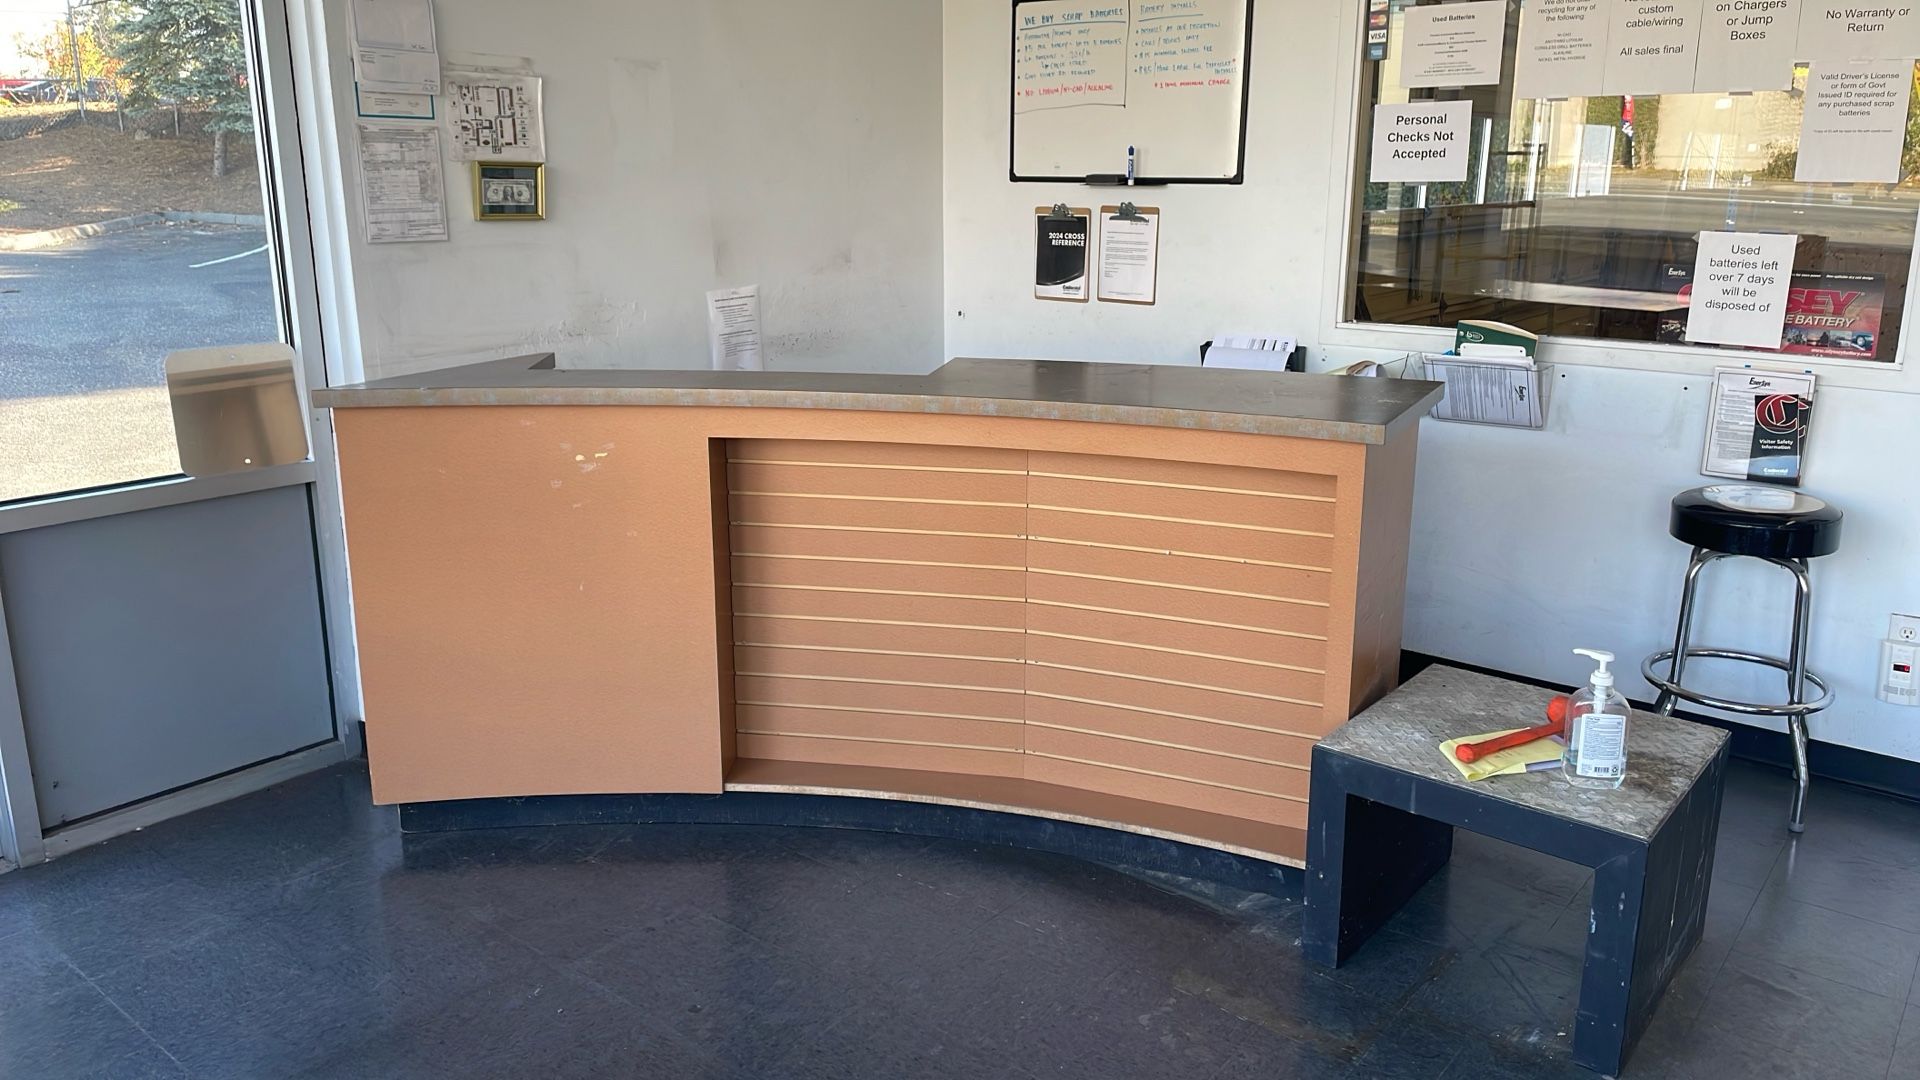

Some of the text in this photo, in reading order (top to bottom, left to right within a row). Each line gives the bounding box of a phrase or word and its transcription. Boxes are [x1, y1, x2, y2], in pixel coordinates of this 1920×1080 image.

[1638, 5, 1674, 14] custom
[1716, 0, 1787, 11] on Chargers
[1826, 8, 1911, 19] No Warranty or
[1024, 16, 1036, 26] WE
[1041, 14, 1054, 24] BUY
[1625, 16, 1684, 28] cable/wiring
[1726, 15, 1773, 26] or Jump
[1847, 22, 1885, 32] Return
[1370, 32, 1386, 40] VISA
[1730, 30, 1766, 40] Boxes
[1620, 44, 1684, 56] All sales final
[1396, 113, 1447, 125] Personal
[1387, 131, 1454, 142] Checks Not
[1392, 148, 1446, 160] Accepted
[1064, 232, 1085, 240] CROSS
[1731, 244, 1761, 255] Used
[1709, 257, 1778, 270] batteries left
[1709, 273, 1775, 286] over 7 days
[1722, 287, 1757, 297] will be
[1705, 299, 1771, 312] disposed of
[1795, 315, 1855, 328] BATTERY
